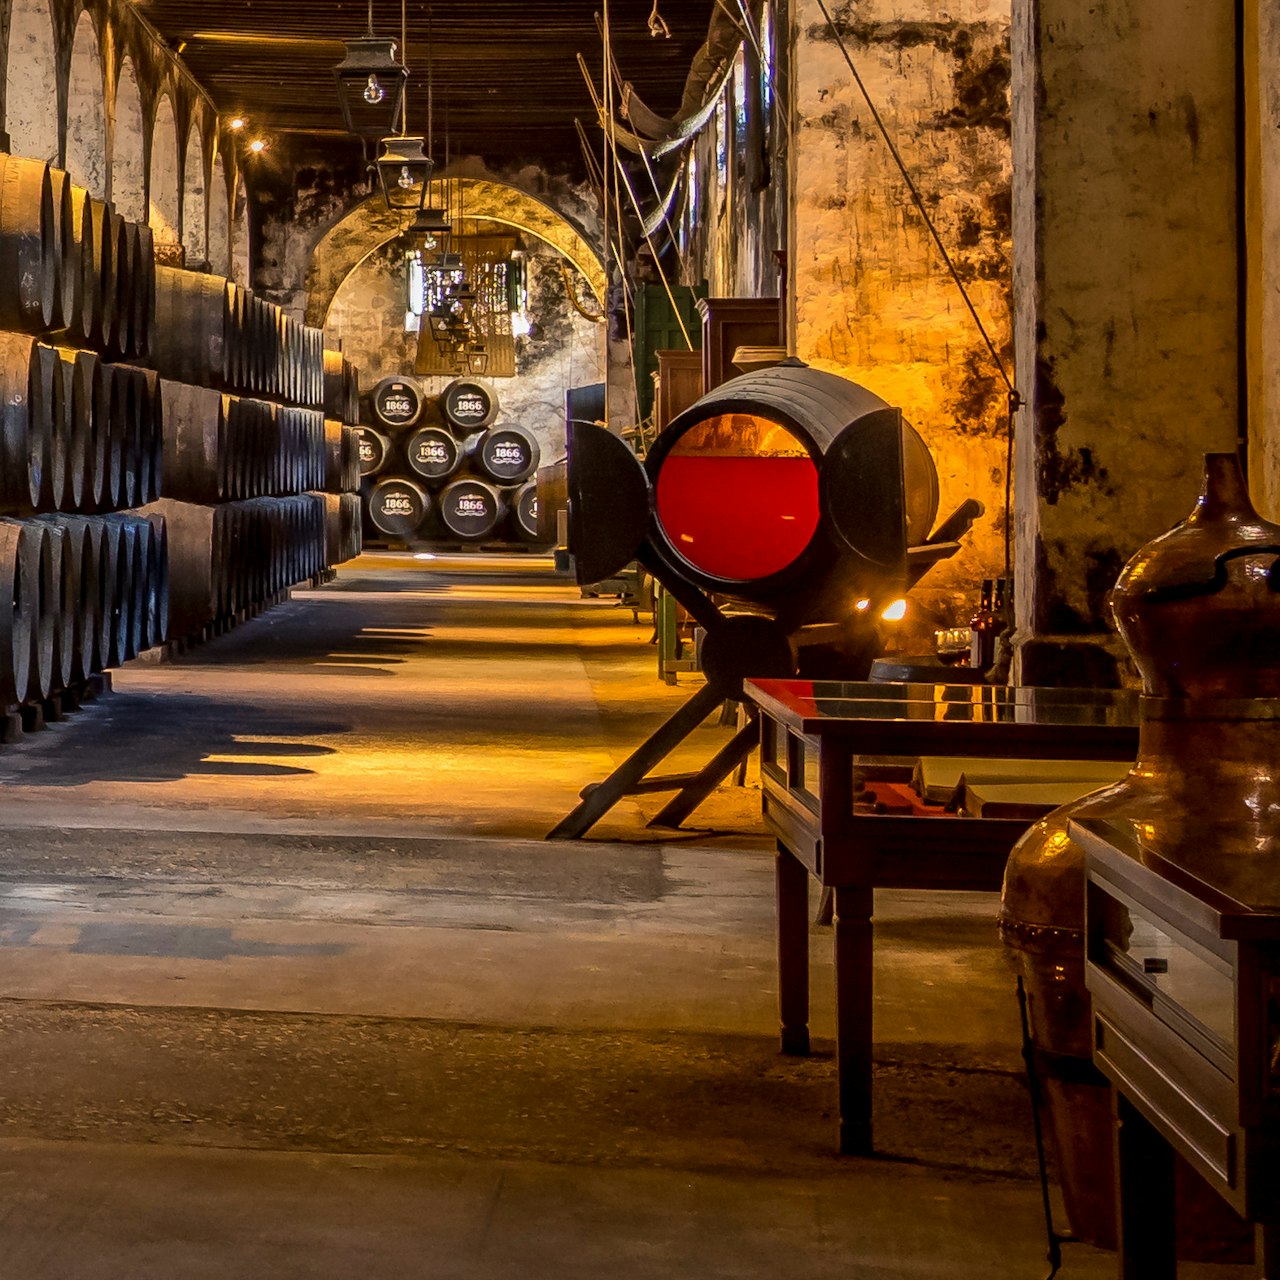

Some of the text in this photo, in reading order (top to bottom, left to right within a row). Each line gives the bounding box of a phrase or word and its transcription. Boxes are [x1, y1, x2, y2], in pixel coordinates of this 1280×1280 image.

[385, 401, 410, 410] 1866
[458, 401, 482, 410] 1866
[420, 447, 444, 456] 1866
[495, 448, 519, 457] 1866
[385, 499, 409, 508] 1866
[459, 500, 483, 510] 1866
